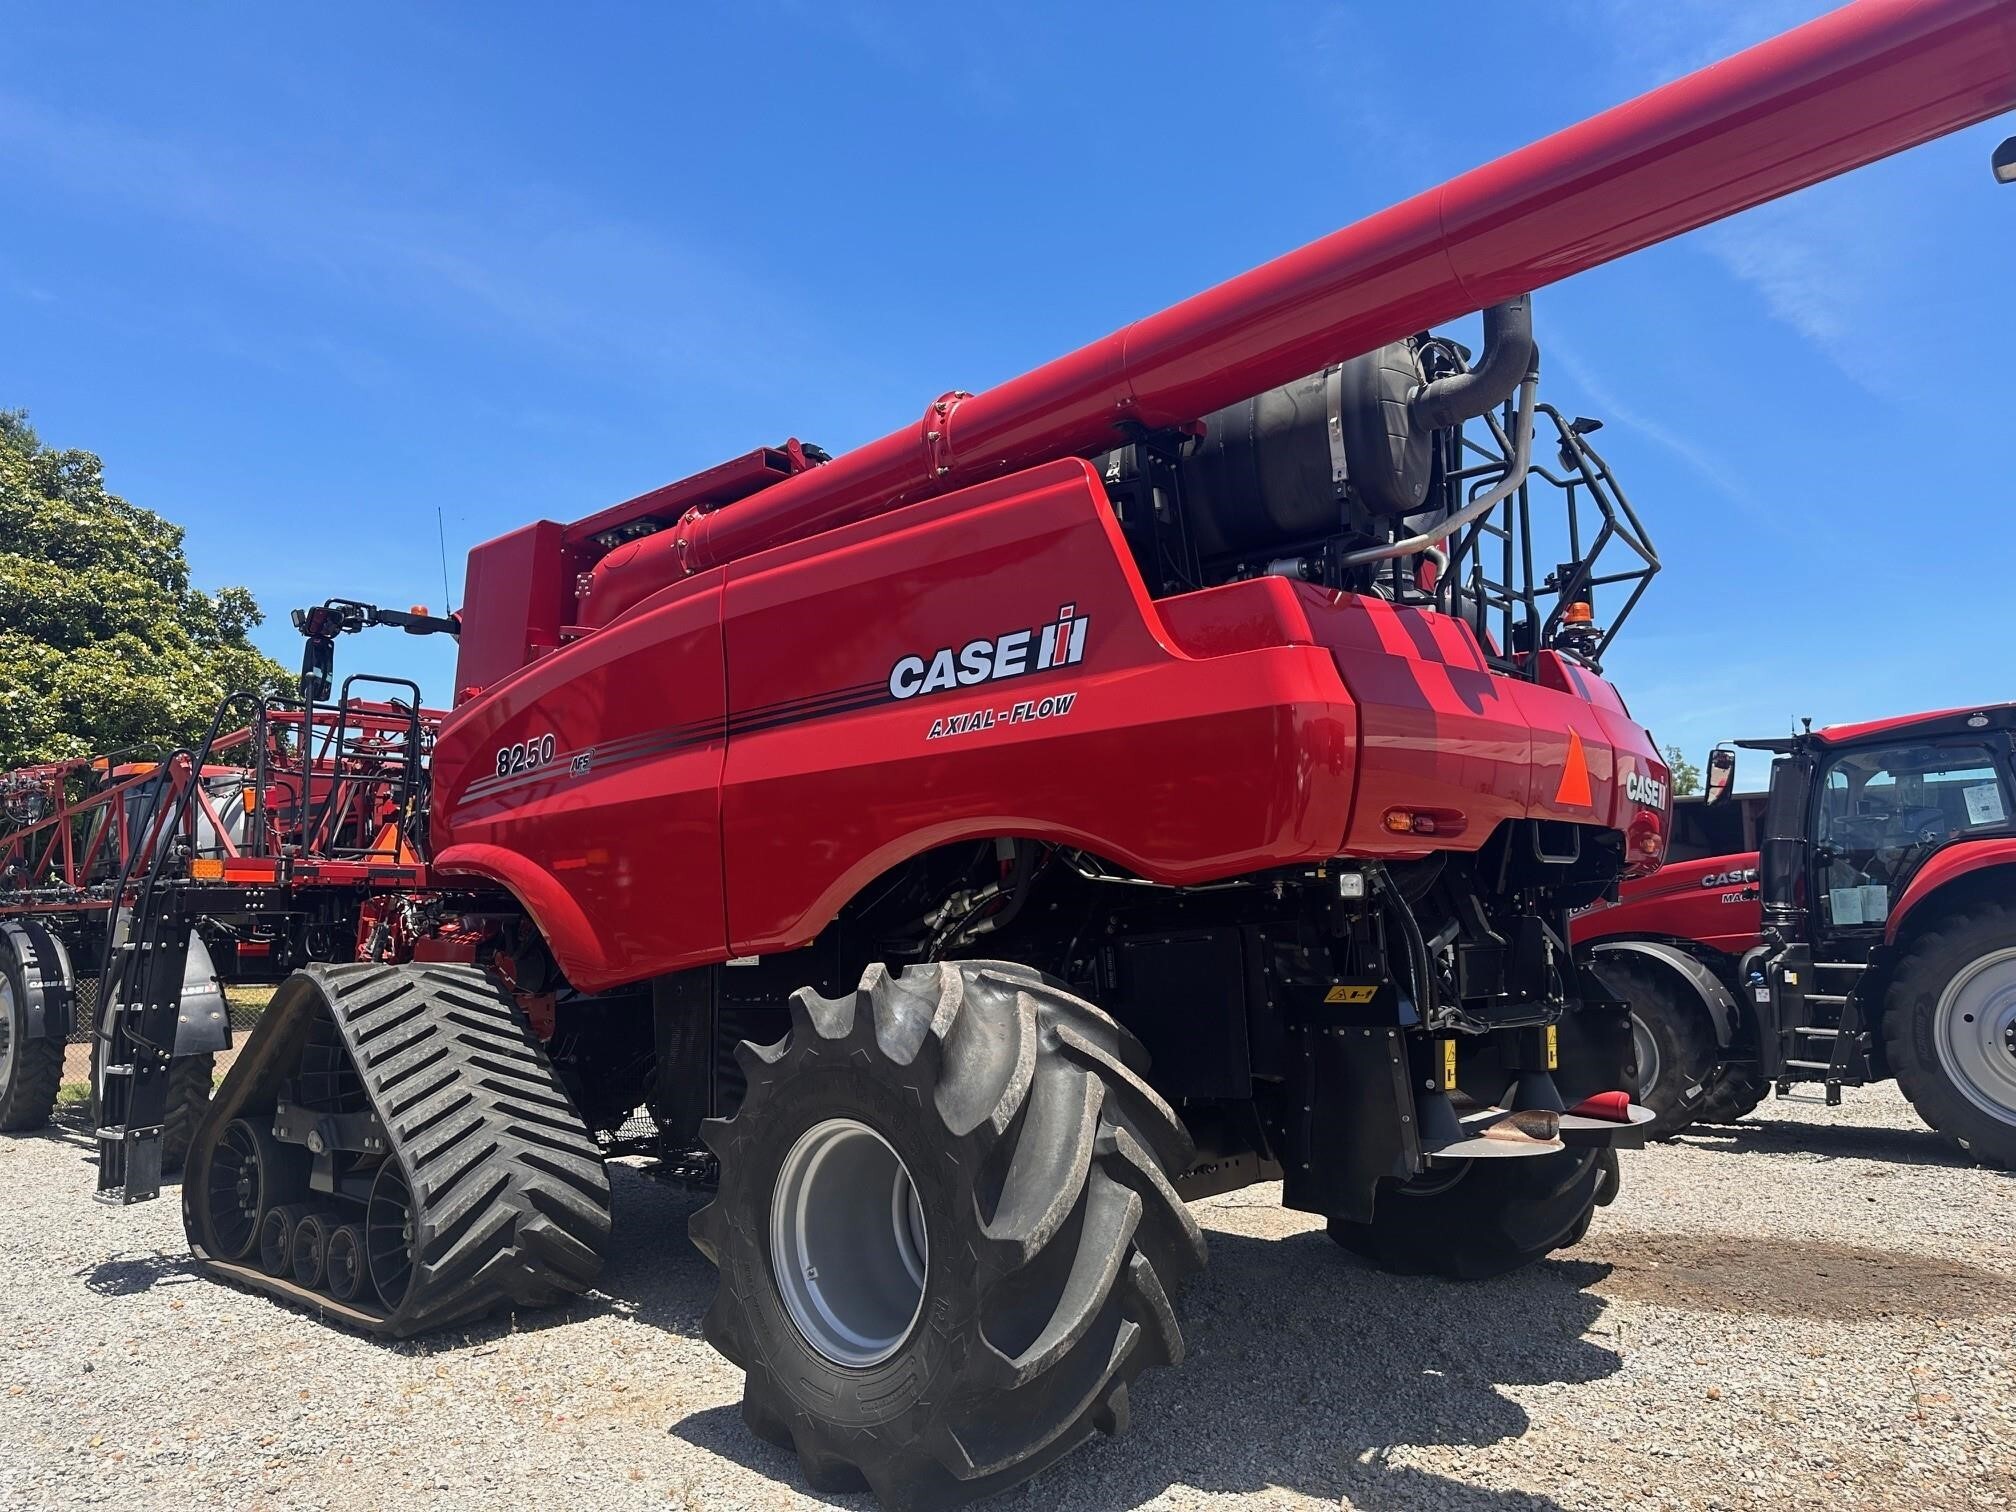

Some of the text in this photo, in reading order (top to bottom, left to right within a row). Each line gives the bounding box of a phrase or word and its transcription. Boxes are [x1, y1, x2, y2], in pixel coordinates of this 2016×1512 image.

[889, 630, 1031, 699] CASE
[926, 692, 1077, 740] AXIAL-FLOW
[496, 733, 556, 777] 8250
[570, 752, 591, 771] AFS
[1626, 772, 1659, 807] CASE
